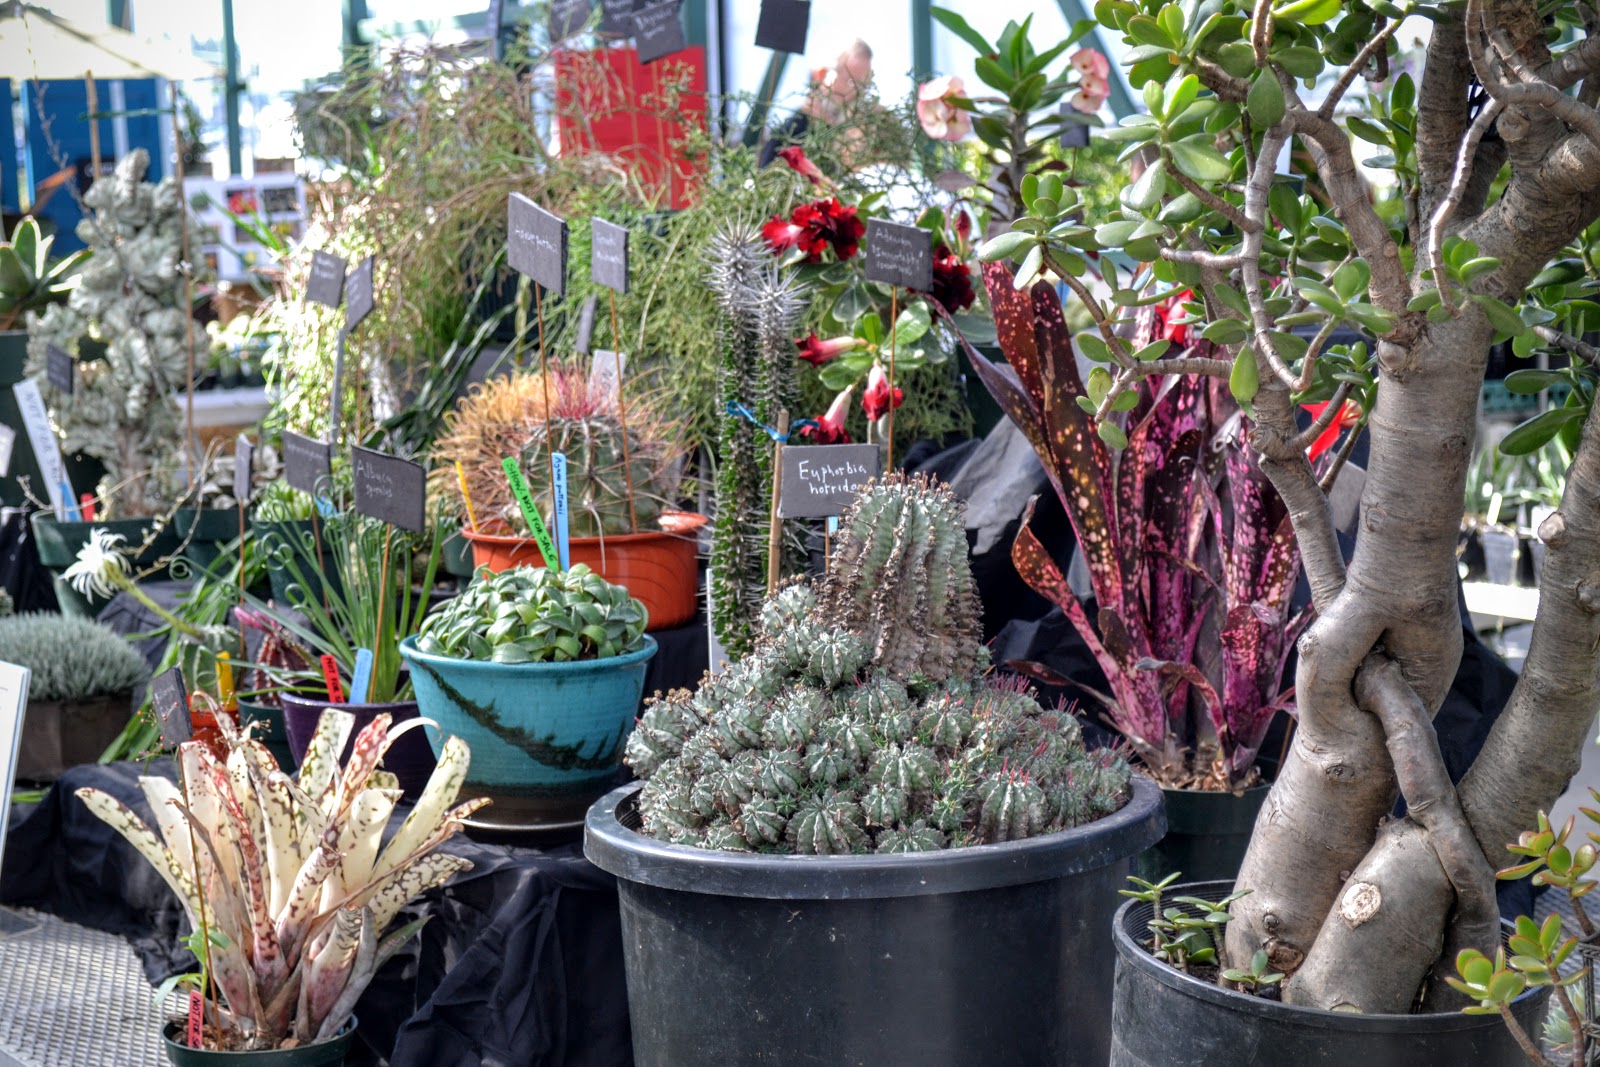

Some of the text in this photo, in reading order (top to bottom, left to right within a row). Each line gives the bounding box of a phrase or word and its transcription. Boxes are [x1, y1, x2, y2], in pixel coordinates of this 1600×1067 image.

[798, 459, 867, 484] Euphorbia
[522, 494, 535, 514] NOT
[532, 517, 544, 535] FOR
[326, 657, 335, 673] NOT
[331, 678, 340, 692] FOR
[192, 996, 201, 1017] NOT
[192, 1017, 201, 1035] FOR
